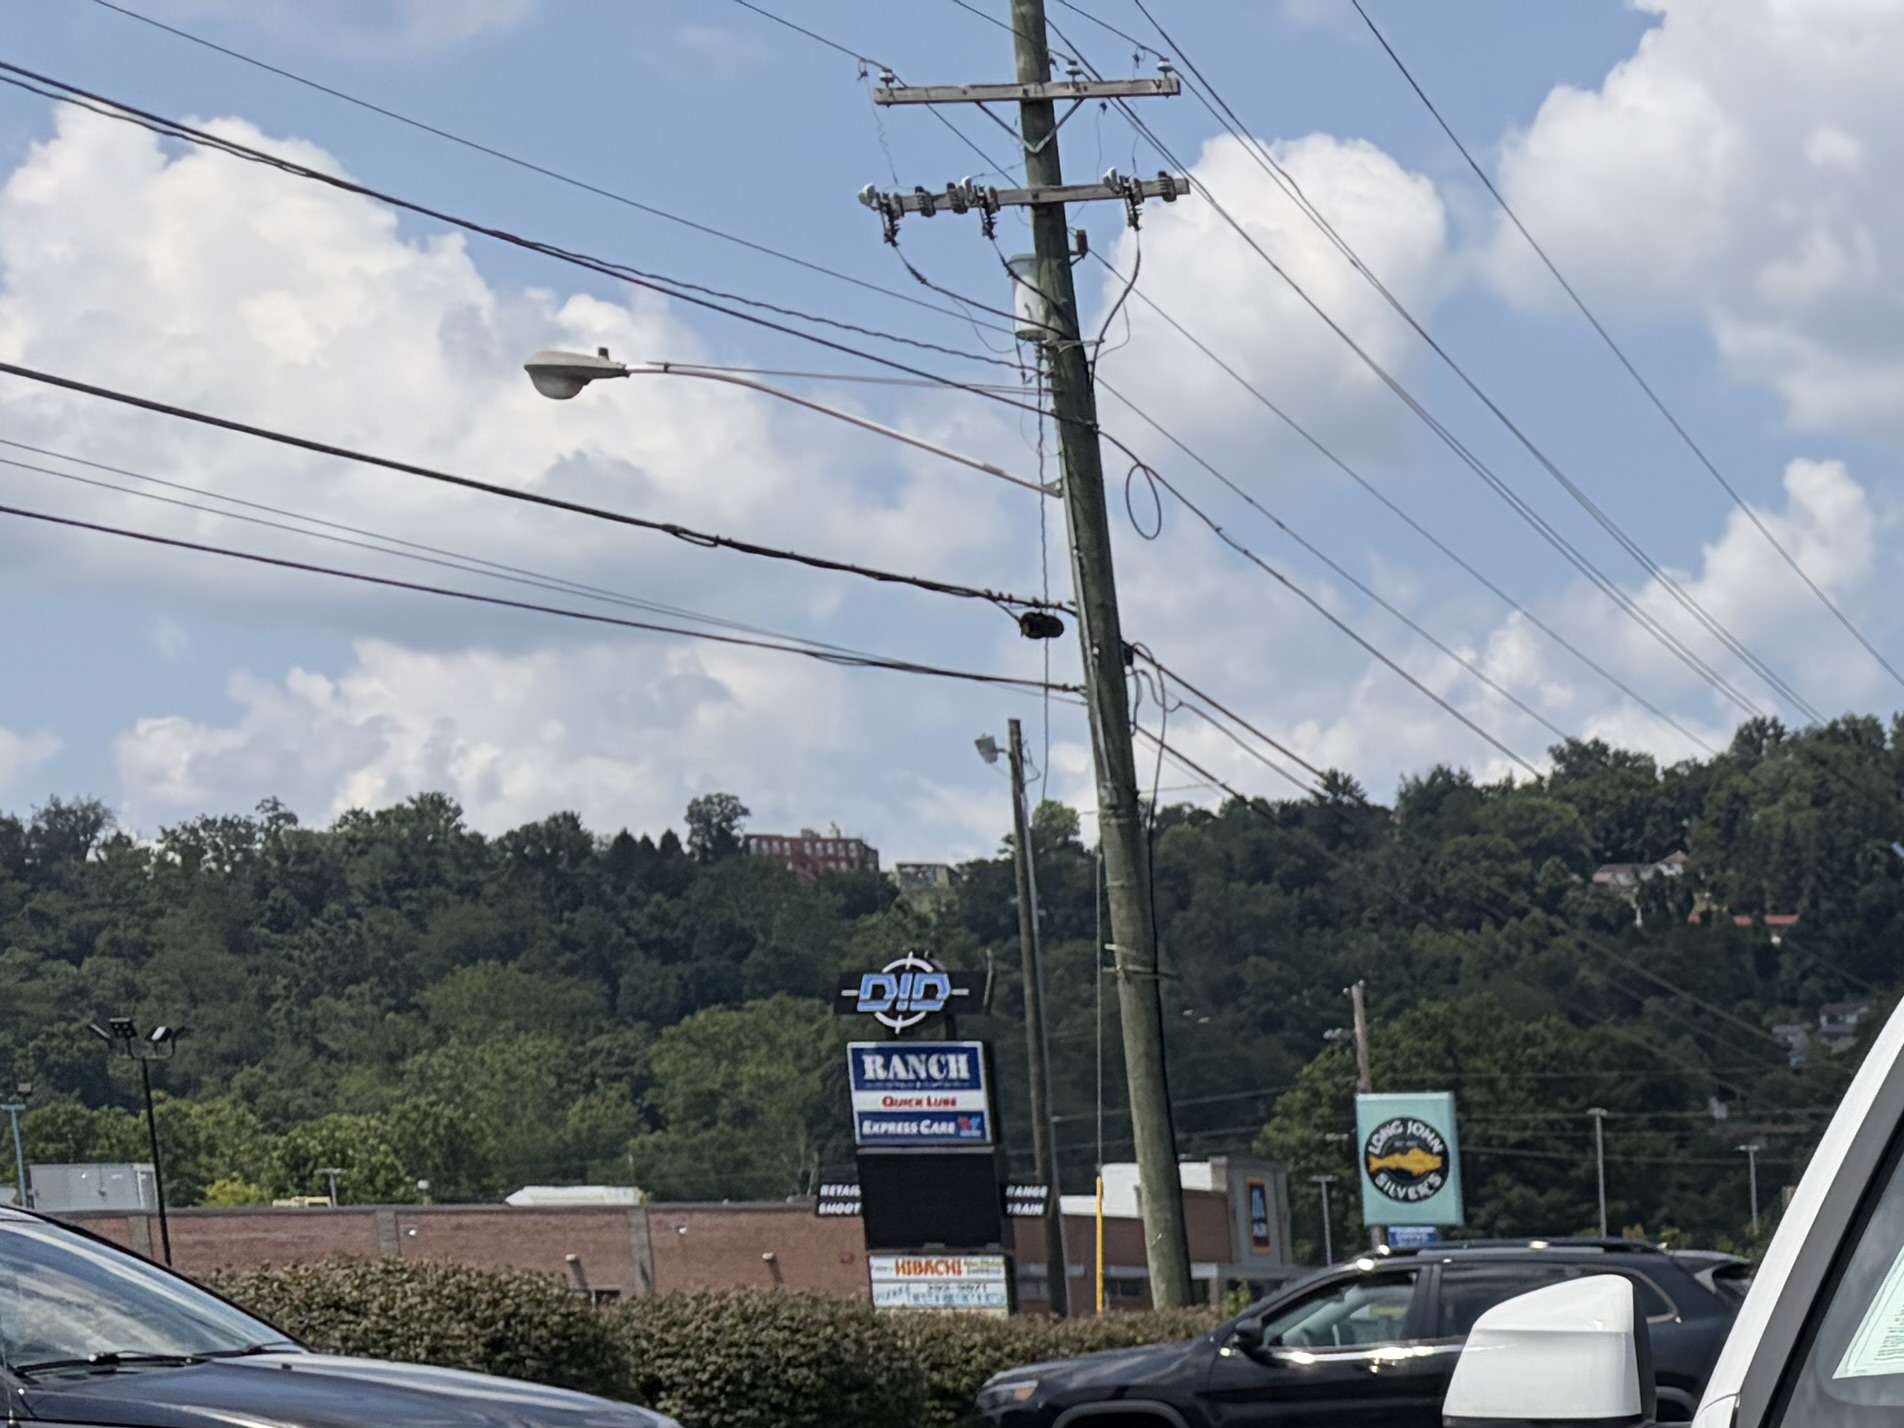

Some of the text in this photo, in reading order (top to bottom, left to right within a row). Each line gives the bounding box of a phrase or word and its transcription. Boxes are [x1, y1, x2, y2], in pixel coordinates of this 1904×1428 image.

[861, 1053, 971, 1080] RANCH
[1368, 1120, 1444, 1155] LONG JOHN
[895, 1258, 963, 1277] HIBACHI
